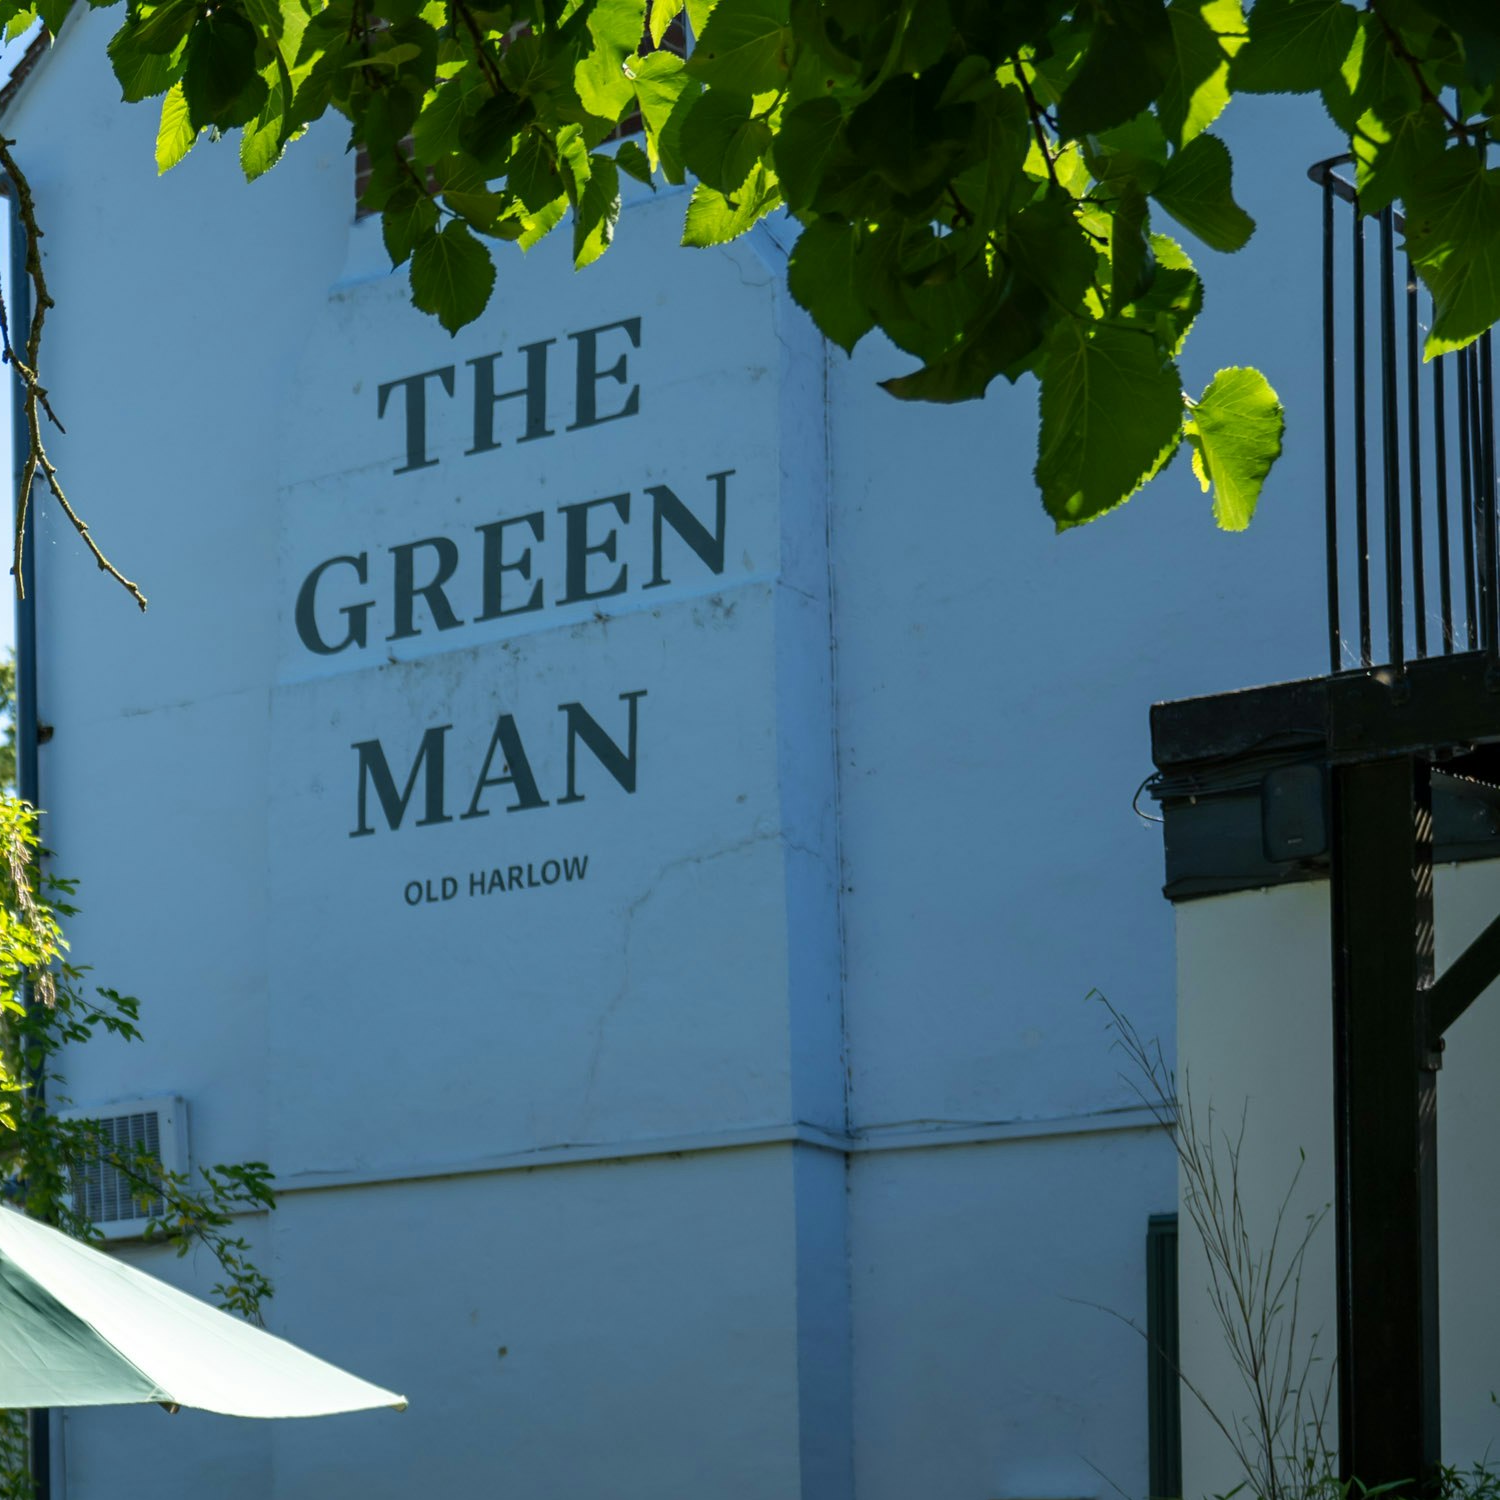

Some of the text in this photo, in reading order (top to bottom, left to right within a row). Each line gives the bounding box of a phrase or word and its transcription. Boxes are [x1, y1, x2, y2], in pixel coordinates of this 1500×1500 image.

[377, 316, 642, 475] THE
[295, 469, 737, 655] GREEN
[349, 689, 648, 838] MAN
[404, 855, 589, 906] OLD HARLOW
